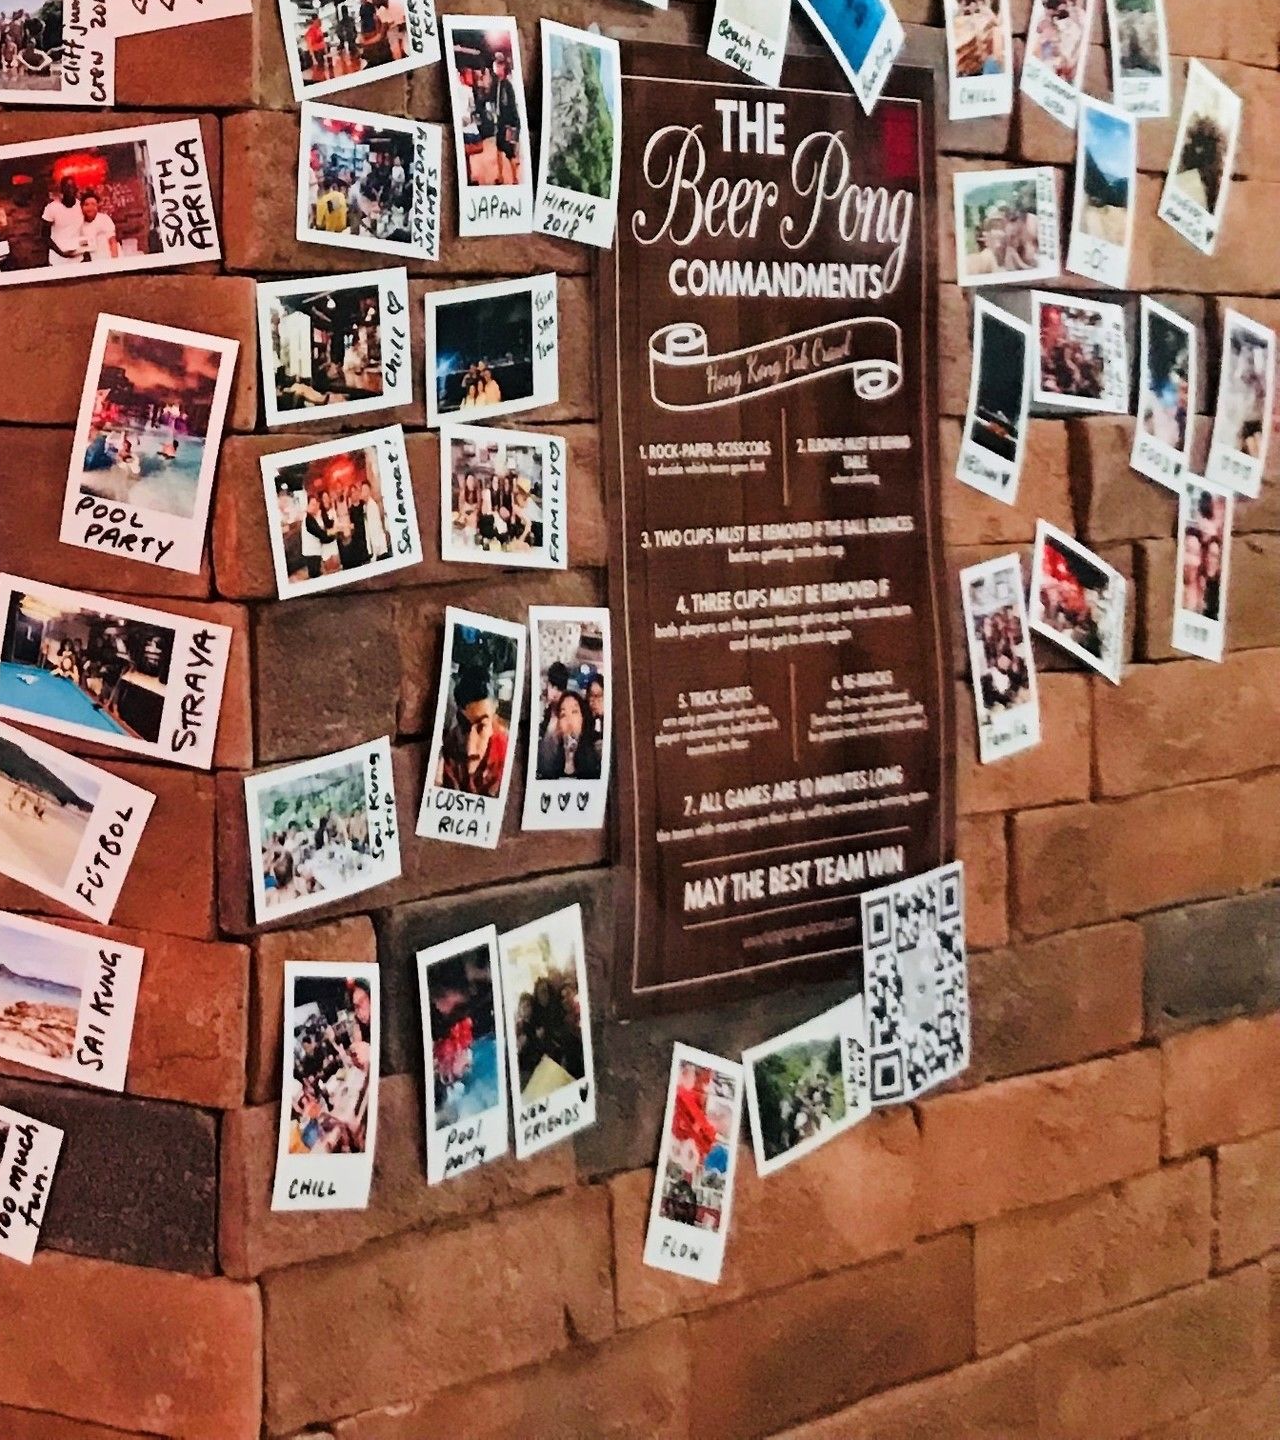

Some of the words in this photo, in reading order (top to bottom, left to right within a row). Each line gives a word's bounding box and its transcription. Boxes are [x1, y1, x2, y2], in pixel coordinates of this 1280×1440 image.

[714, 98, 787, 156] THE
[155, 158, 185, 249] SOUTH
[175, 137, 215, 250] AFRICA
[411, 125, 430, 248] SATURDAY
[466, 196, 523, 222] JAPAN
[541, 190, 596, 224] HIKING
[631, 123, 780, 248] Beer
[779, 130, 915, 295] Pong
[542, 212, 580, 239] 2018
[668, 258, 884, 301] COMMANDMENTS
[383, 326, 407, 389] Chill
[74, 495, 144, 528] POOL
[654, 529, 682, 547] TWO
[683, 527, 714, 546] CUPS
[715, 525, 745, 544] MUST
[83, 522, 175, 562] PARTY
[675, 594, 691, 616] 4.
[690, 590, 731, 614] THREE
[733, 588, 768, 610] CUPS
[769, 584, 804, 606] MUST
[170, 628, 218, 754] STRAYA
[699, 791, 723, 814] ALL
[724, 783, 771, 810] GAMES
[772, 779, 798, 804] ARE
[814, 769, 869, 797] MINUTES
[868, 764, 906, 788] LONG
[683, 876, 730, 911] MAY
[730, 869, 766, 904] THE
[768, 860, 811, 895] BEST
[813, 852, 866, 887] TEAM
[866, 844, 906, 877] WIN
[90, 947, 123, 1018] KUNG
[76, 1022, 105, 1071] SAI
[522, 1102, 580, 1146] FRIENDS
[287, 1177, 338, 1200] CHILL
